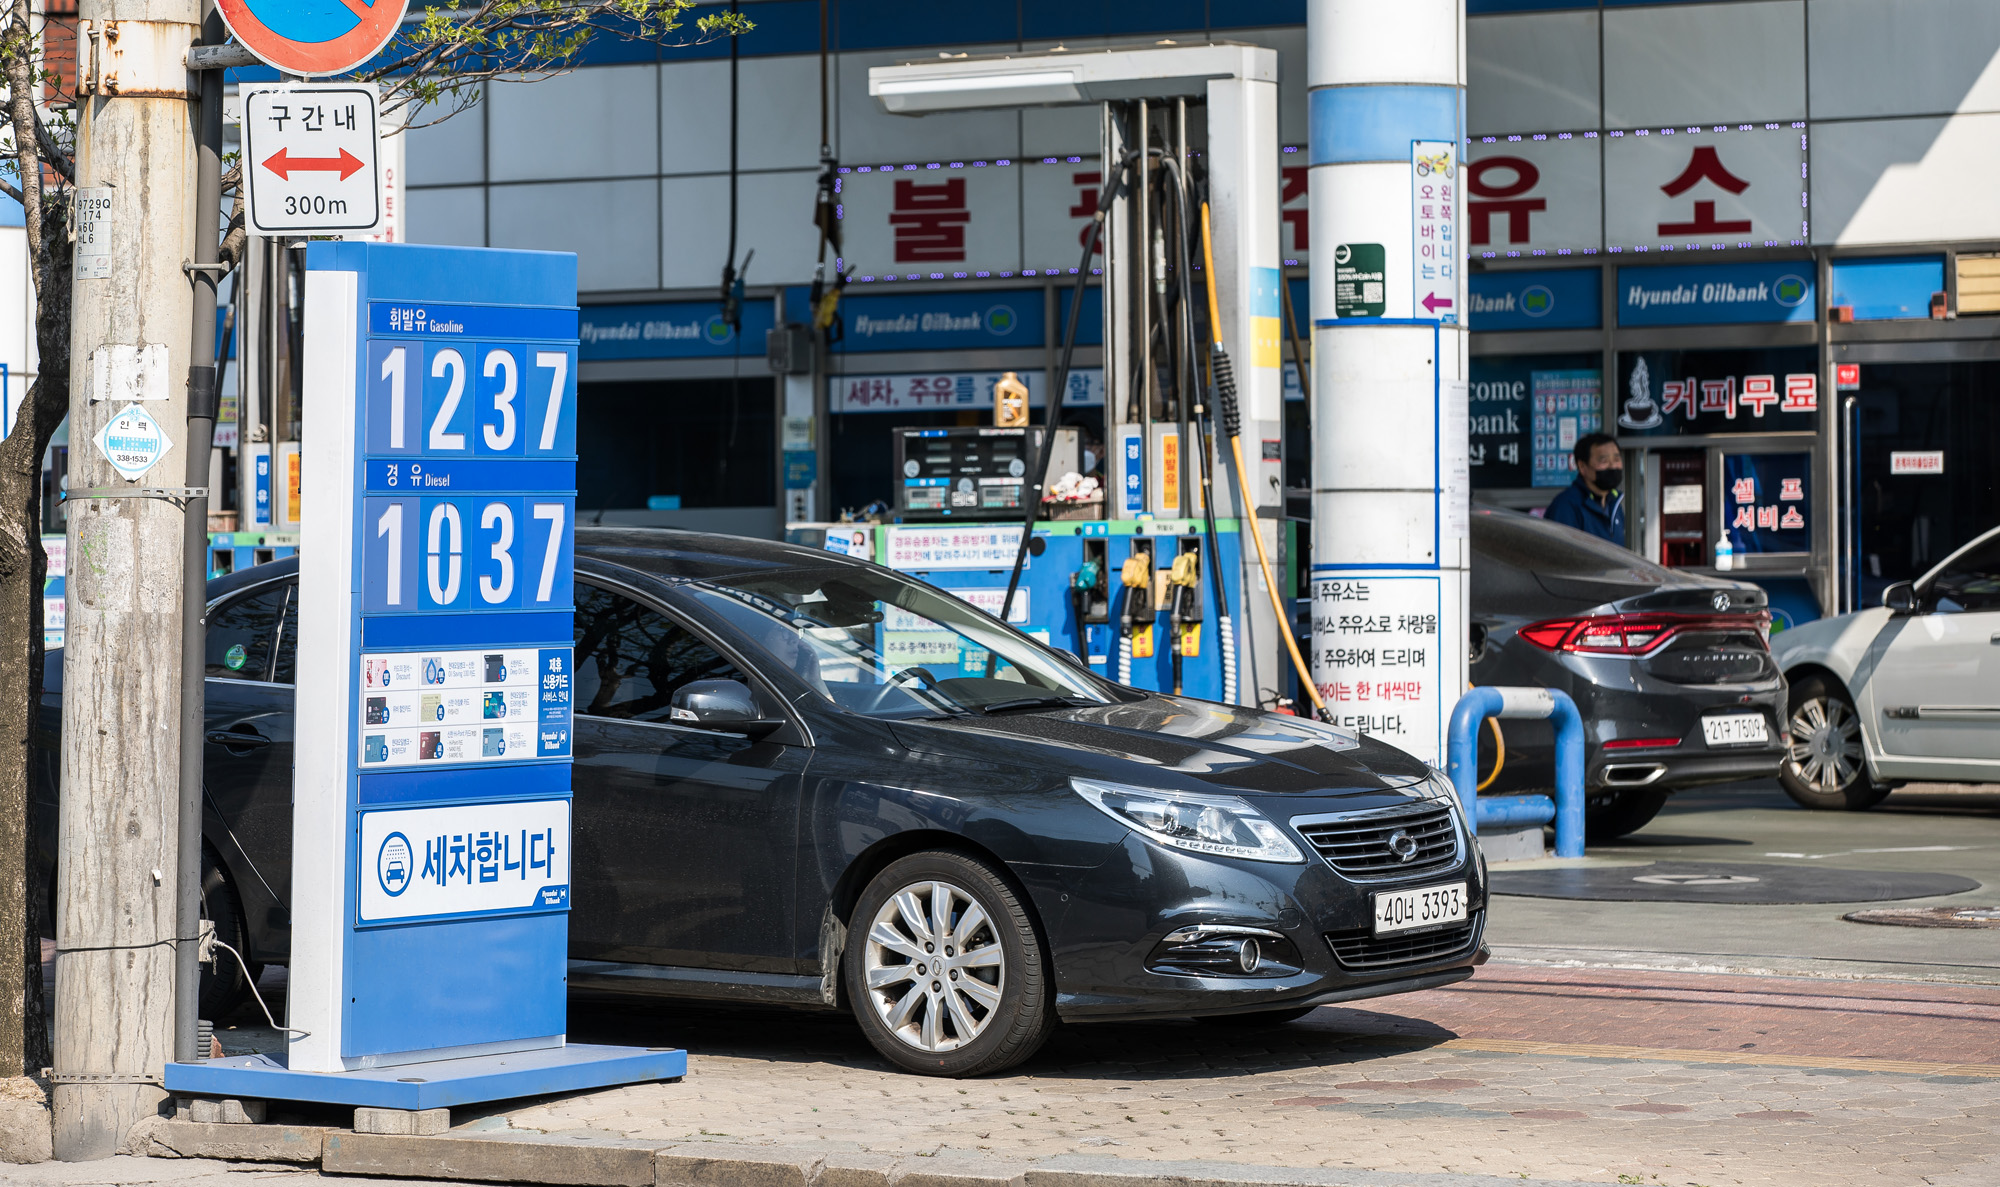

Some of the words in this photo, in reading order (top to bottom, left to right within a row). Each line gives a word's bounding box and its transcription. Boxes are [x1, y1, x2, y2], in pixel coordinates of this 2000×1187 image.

[83, 211, 101, 220] 174
[285, 195, 347, 215] 300m
[1420, 185, 1435, 279] 오토바이는
[1441, 185, 1453, 280] 왼쪽입니다
[1628, 284, 1698, 309] Hyundai
[1702, 281, 1768, 304] Oilbank
[389, 307, 427, 332] 휘발유
[429, 319, 464, 333] Gasoline
[580, 321, 640, 340] Hyundai
[644, 320, 701, 339] Oilbank
[855, 313, 919, 336] Hyundai
[922, 313, 981, 333] Oilbank
[381, 345, 568, 451] 1237
[1662, 373, 1818, 420] 커피무료
[116, 454, 148, 463] 338-1533
[387, 463, 422, 487] 경유
[425, 474, 450, 487] Diesel
[1733, 505, 1804, 532] 서비스
[378, 501, 566, 606] 1037
[1321, 582, 1370, 602] 주유소는
[1338, 615, 1392, 635] 주유소로
[1397, 614, 1437, 635] 차량을
[1325, 648, 1375, 668] 주유하여
[1381, 647, 1426, 668] 드리며
[543, 674, 568, 690] 신용카드
[1356, 682, 1371, 701] 한
[1377, 682, 1421, 701] 대씩만
[1344, 714, 1406, 735] 드립니다.
[1734, 718, 1760, 738] 7509
[421, 827, 555, 887] 세차합니다
[1384, 897, 1414, 926] 40너
[1422, 888, 1459, 921] 3393
